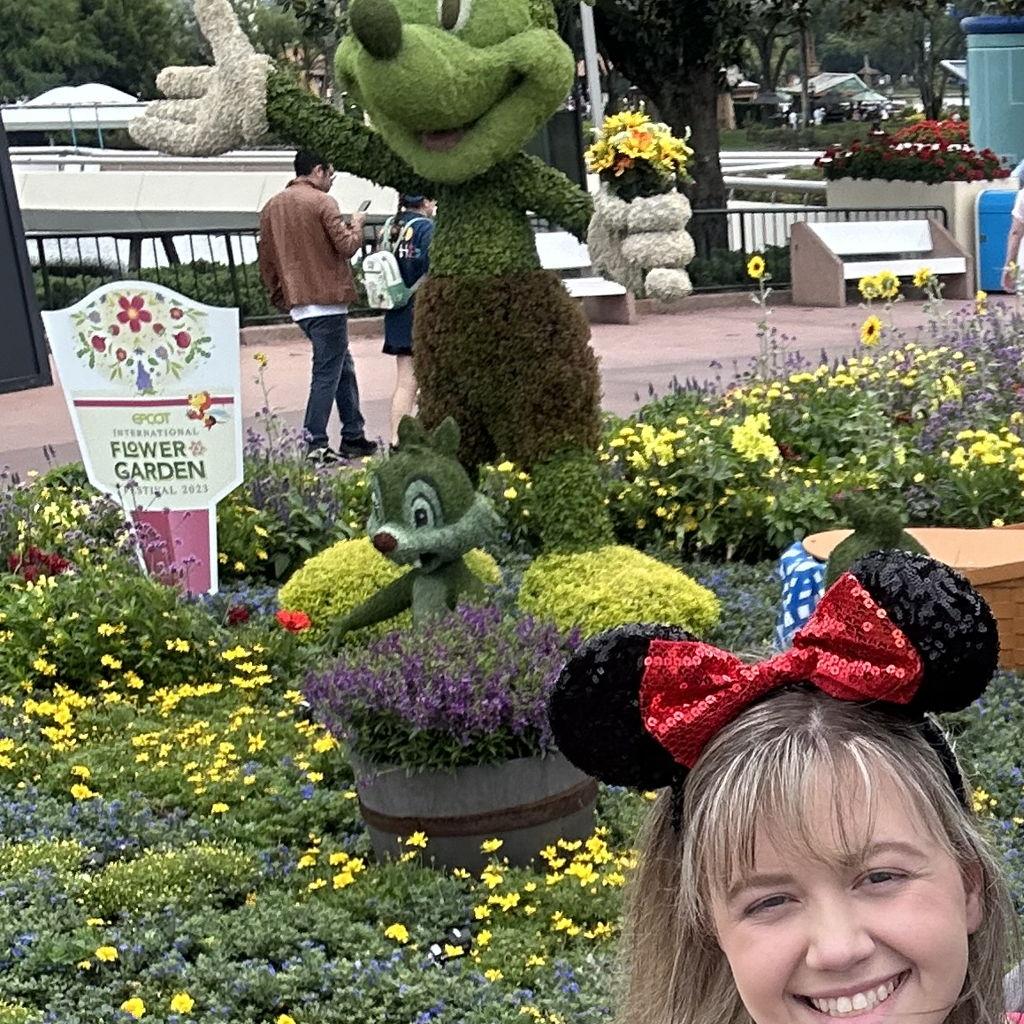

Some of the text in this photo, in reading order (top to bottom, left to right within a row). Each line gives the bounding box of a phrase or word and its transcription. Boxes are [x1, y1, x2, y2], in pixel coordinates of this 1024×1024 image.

[132, 412, 170, 424] EPCOT
[113, 427, 199, 437] INTERNATIONAL
[110, 441, 186, 458] FLOWER
[114, 461, 206, 480] GARDEN
[124, 484, 208, 495] FSTIVAL 2023
